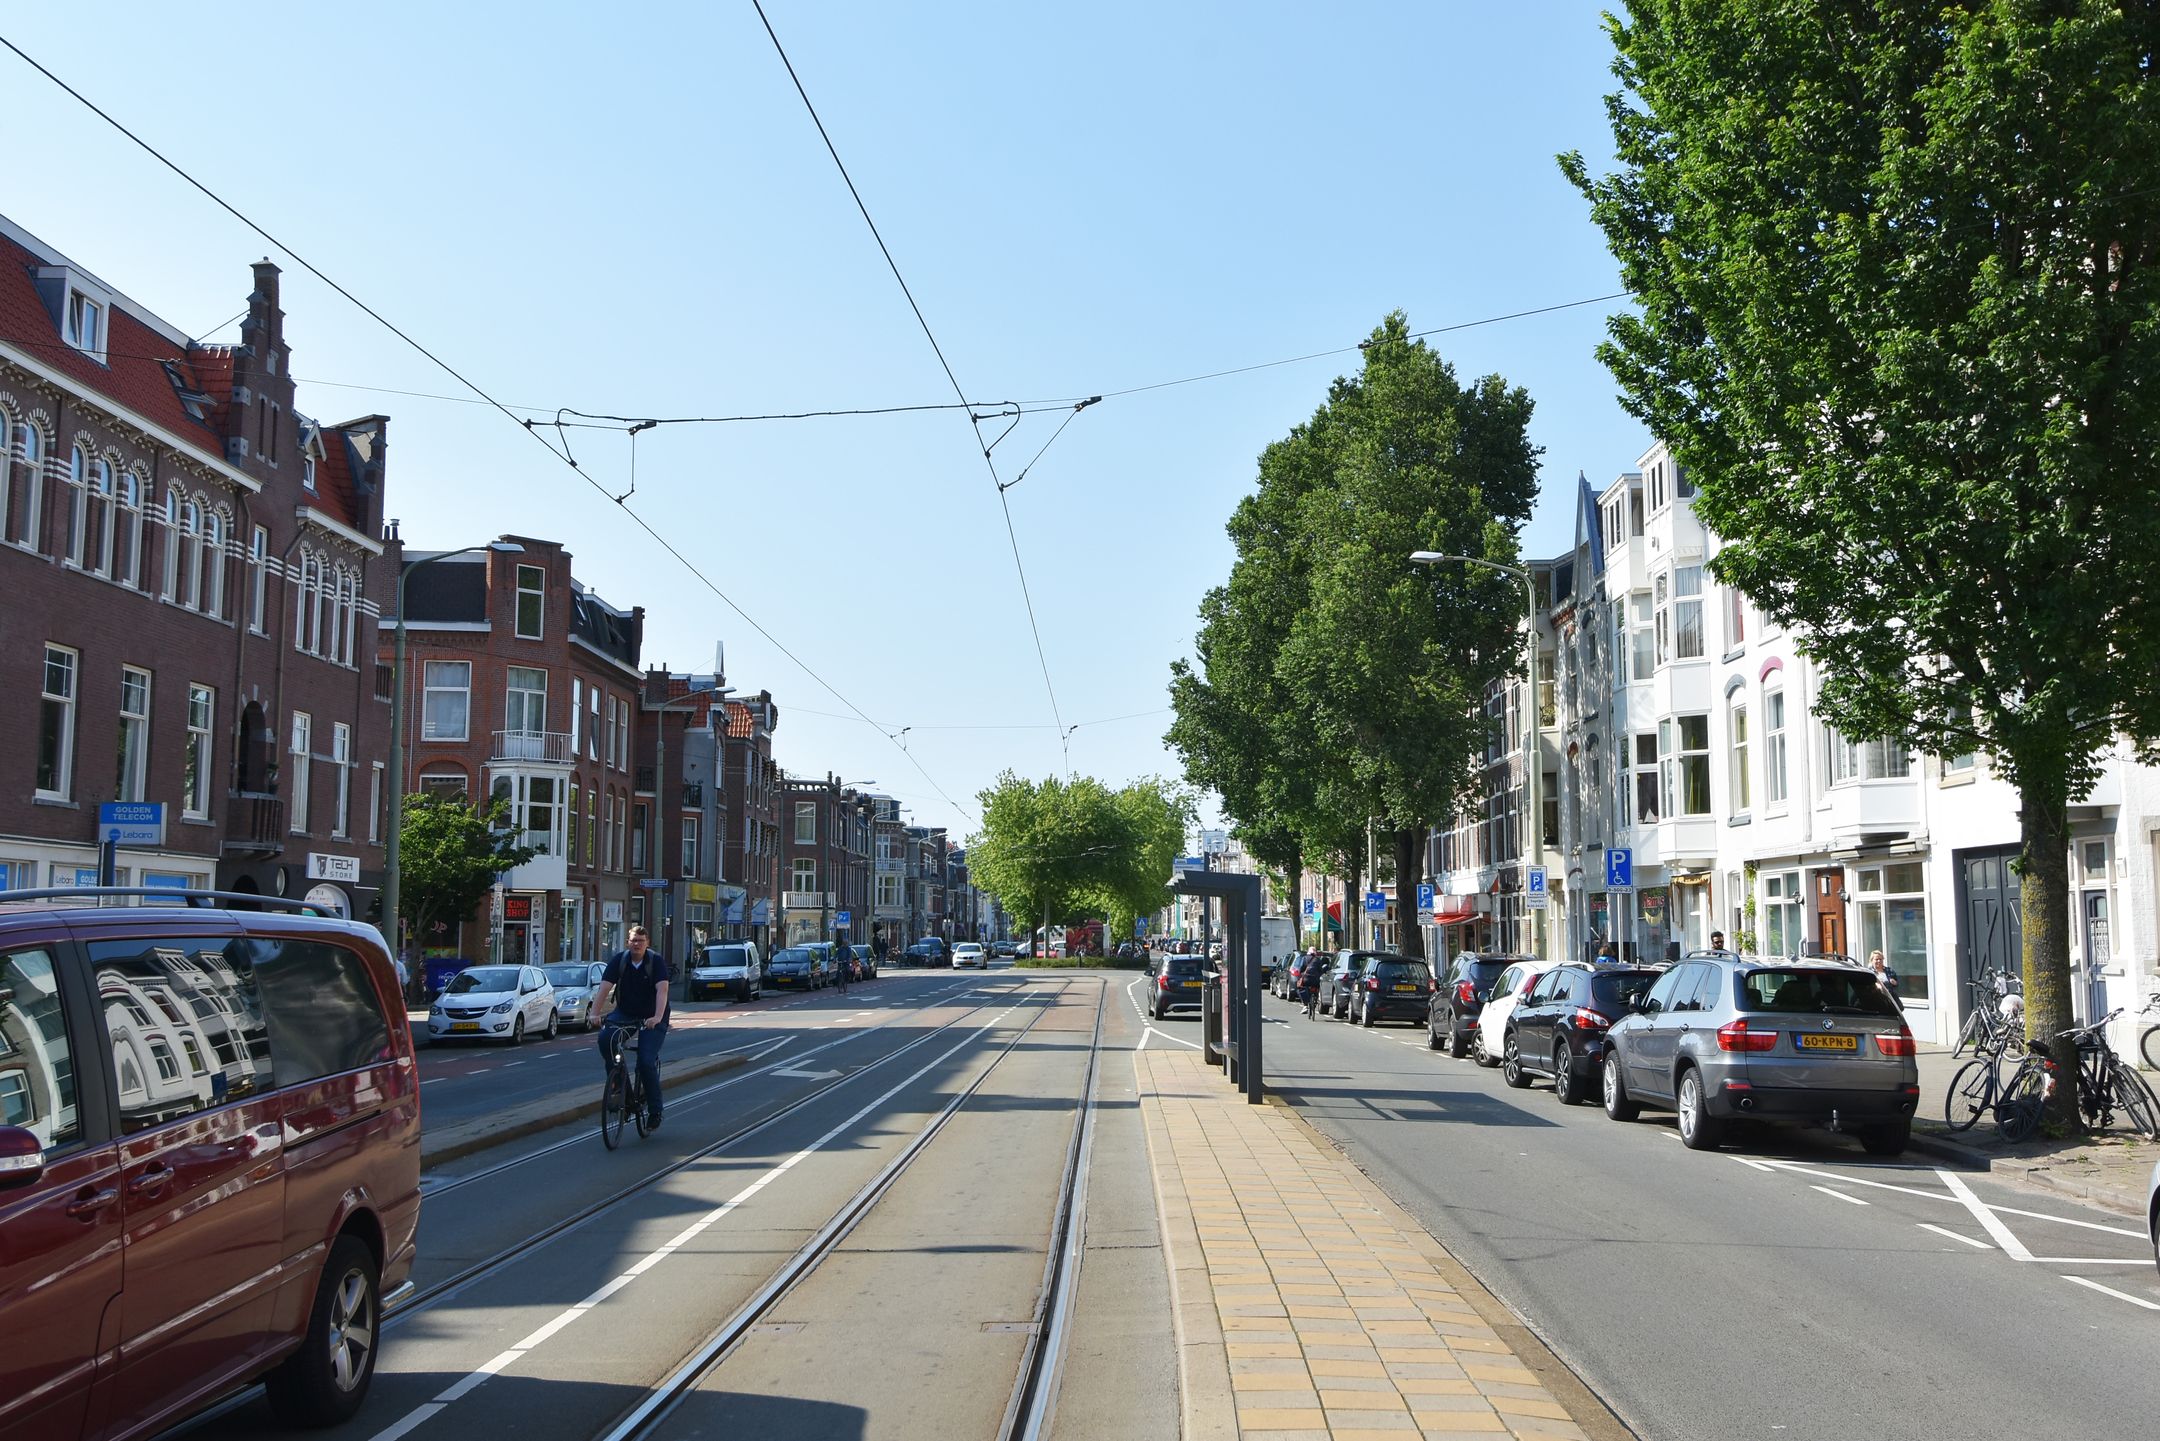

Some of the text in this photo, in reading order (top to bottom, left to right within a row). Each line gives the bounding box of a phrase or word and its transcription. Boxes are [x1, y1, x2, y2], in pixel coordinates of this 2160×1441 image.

[113, 813, 153, 821] TELECOM
[122, 831, 153, 839] Lebara
[1611, 850, 1626, 870] P
[329, 871, 353, 879] STORE
[1533, 876, 1541, 885] P
[1421, 886, 1430, 899] P
[507, 900, 529, 908] KING
[1305, 900, 1312, 909] P
[1368, 898, 1376, 907] P
[1804, 1036, 1854, 1047] 60-KPN-8
